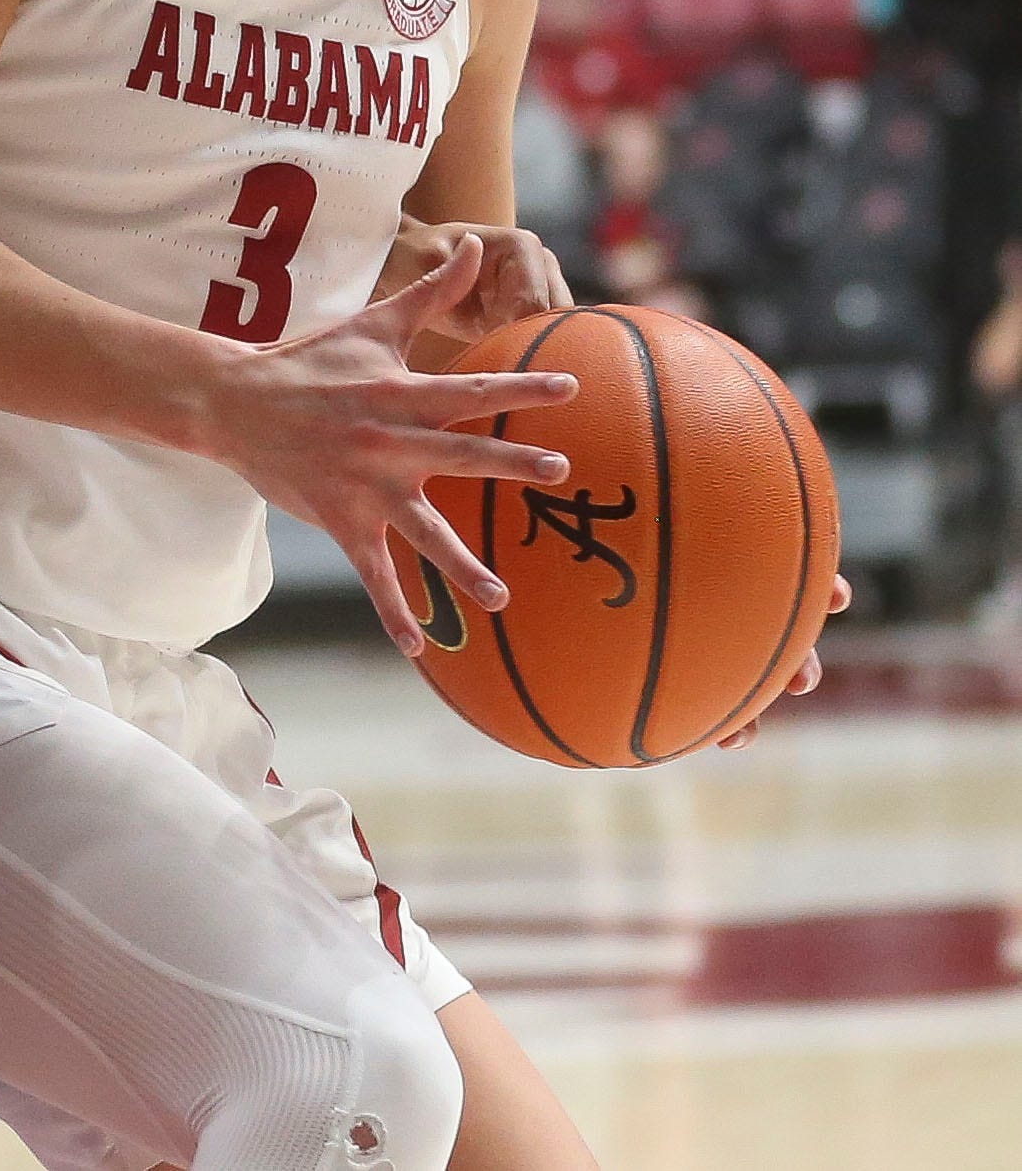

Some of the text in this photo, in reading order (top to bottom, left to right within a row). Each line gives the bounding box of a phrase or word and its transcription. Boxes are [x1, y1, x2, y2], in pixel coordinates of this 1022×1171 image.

[126, 0, 430, 149] ALABAMA
[199, 162, 317, 344] 3
[520, 484, 637, 608] A
